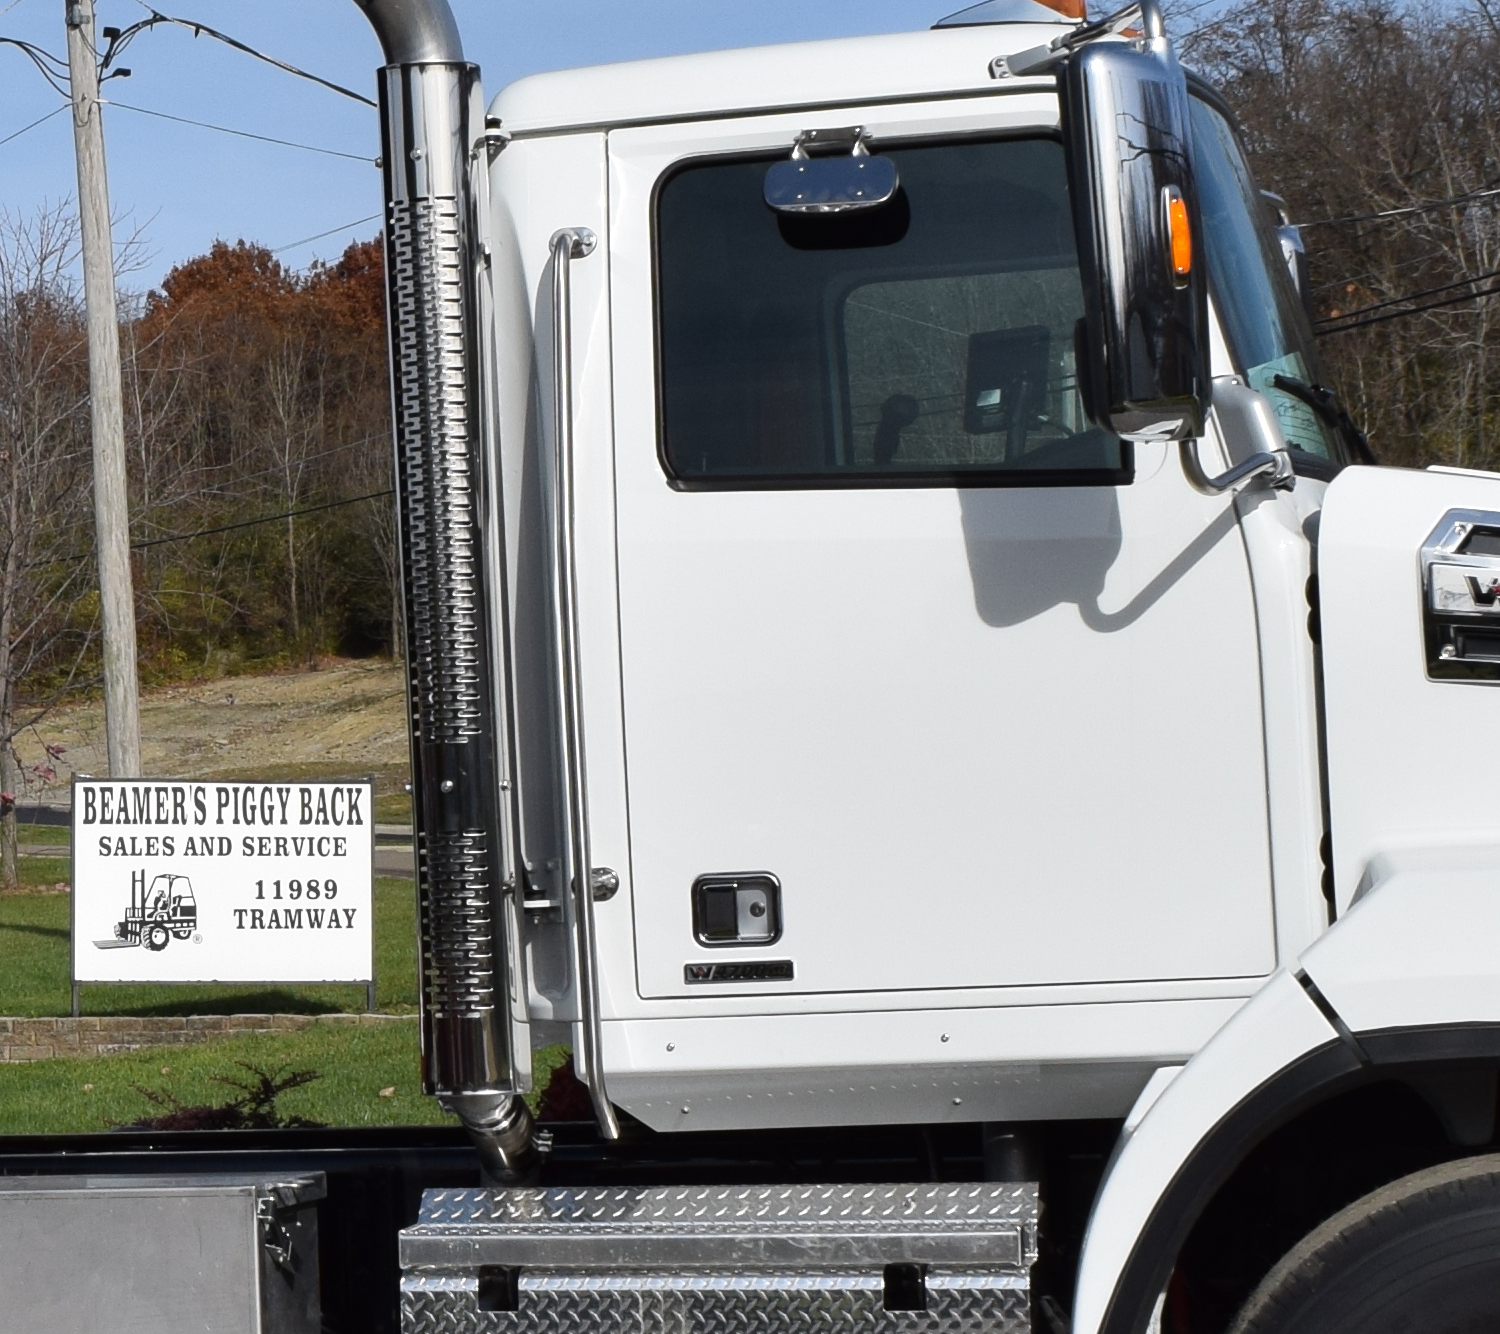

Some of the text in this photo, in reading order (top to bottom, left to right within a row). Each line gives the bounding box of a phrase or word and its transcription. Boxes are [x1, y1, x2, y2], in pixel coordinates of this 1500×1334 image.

[82, 785, 363, 826] BEAMER'S PIGGY BACK
[98, 835, 347, 857] SALES AND SERVICE
[254, 879, 338, 900] 11989
[233, 907, 357, 930] TRAMWAY
